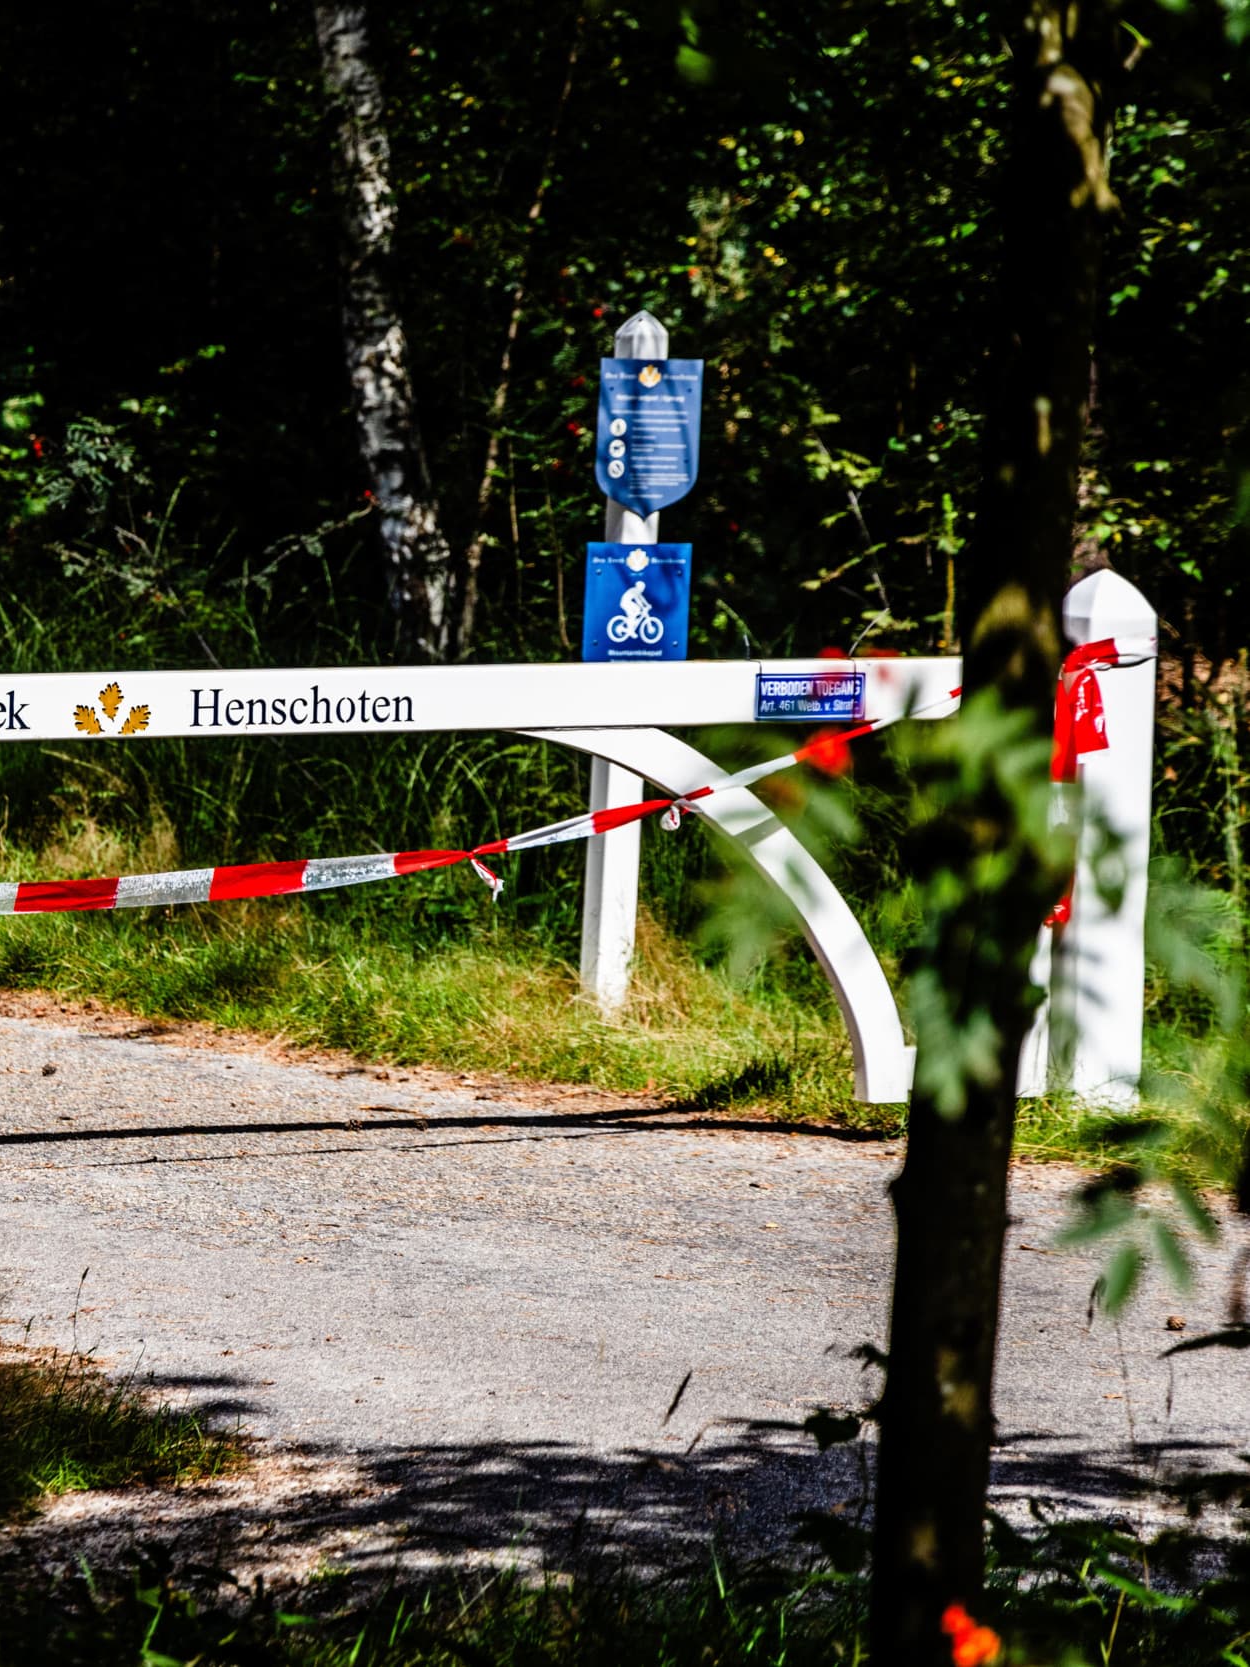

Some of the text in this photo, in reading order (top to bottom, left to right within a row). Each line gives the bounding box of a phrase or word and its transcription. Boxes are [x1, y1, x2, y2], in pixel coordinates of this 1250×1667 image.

[760, 680, 861, 696] VERBODEN TOEGANG
[190, 685, 414, 727] Henschoten
[760, 700, 777, 712] Art.
[779, 700, 795, 711] 461
